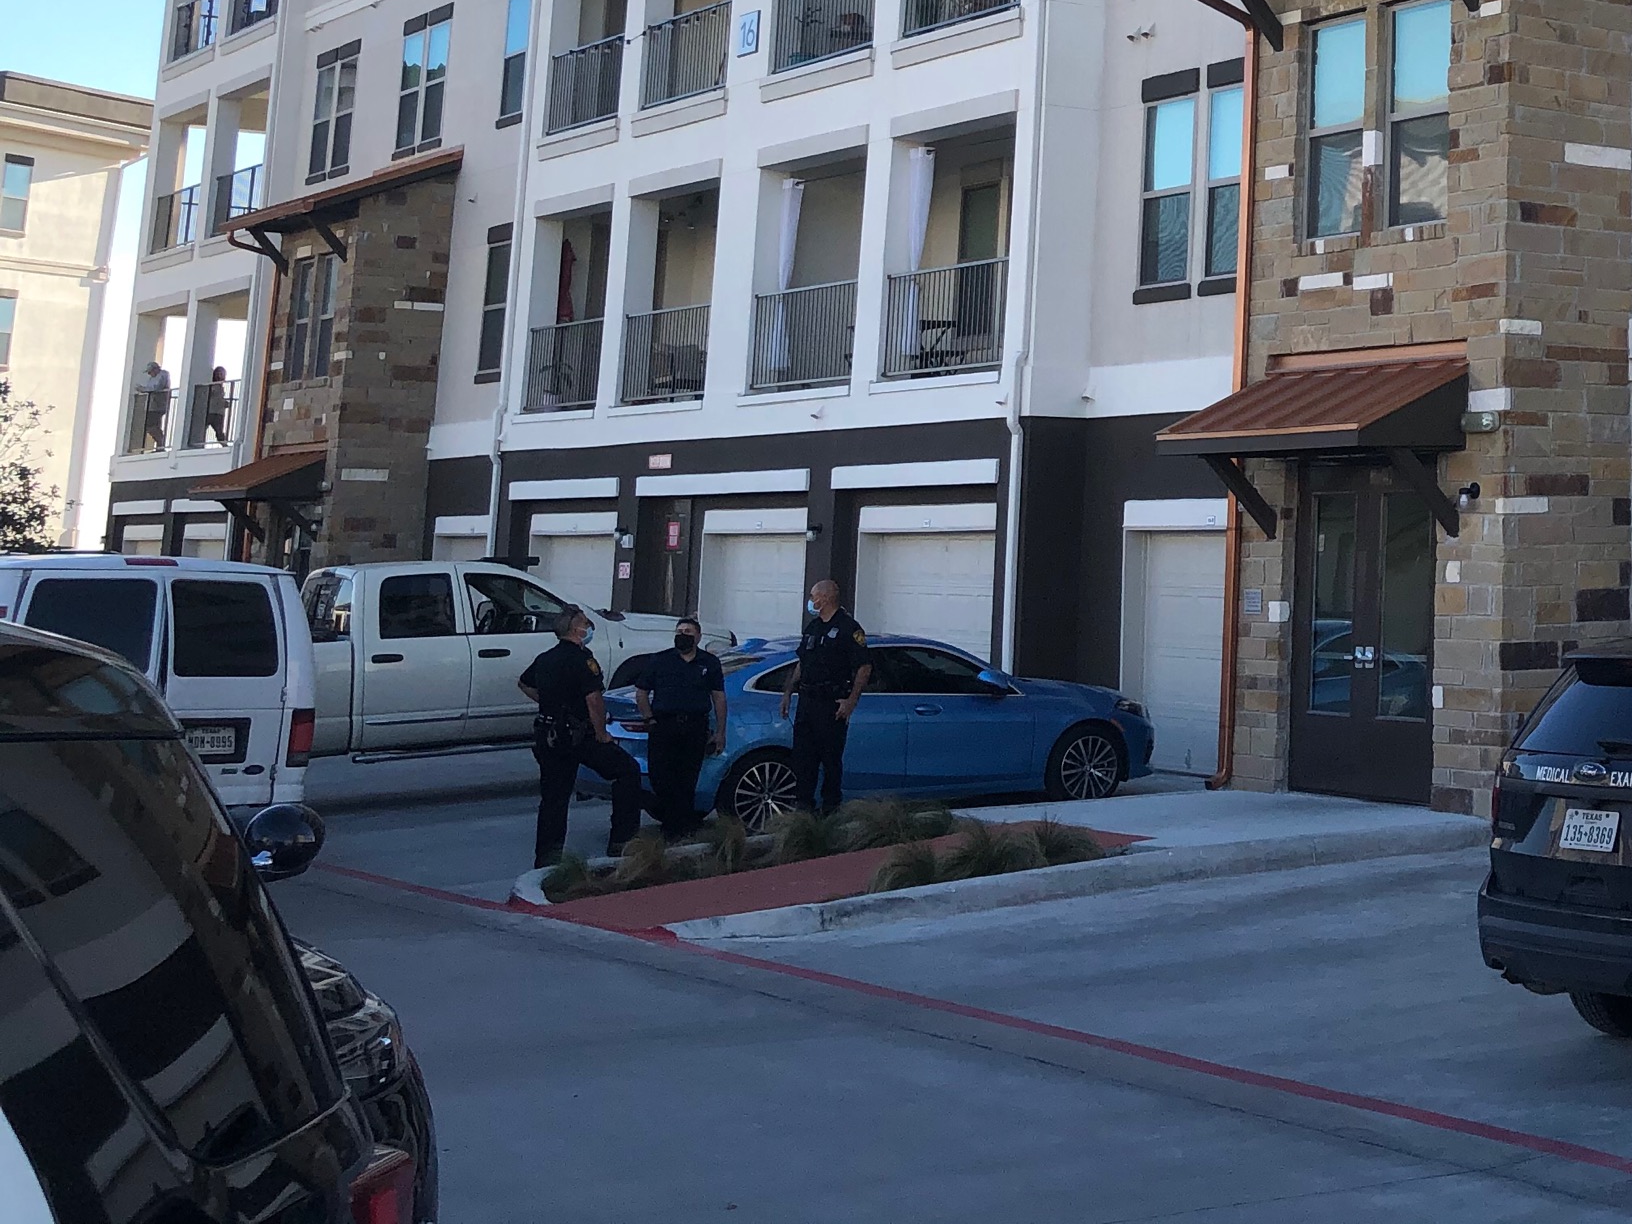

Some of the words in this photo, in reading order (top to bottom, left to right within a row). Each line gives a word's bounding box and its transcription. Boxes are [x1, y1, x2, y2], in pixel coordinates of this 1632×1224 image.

[740, 19, 756, 49] 16
[1535, 765, 1570, 784] MEDICAL
[1580, 764, 1598, 776] Ford
[1582, 812, 1603, 822] TEXAS
